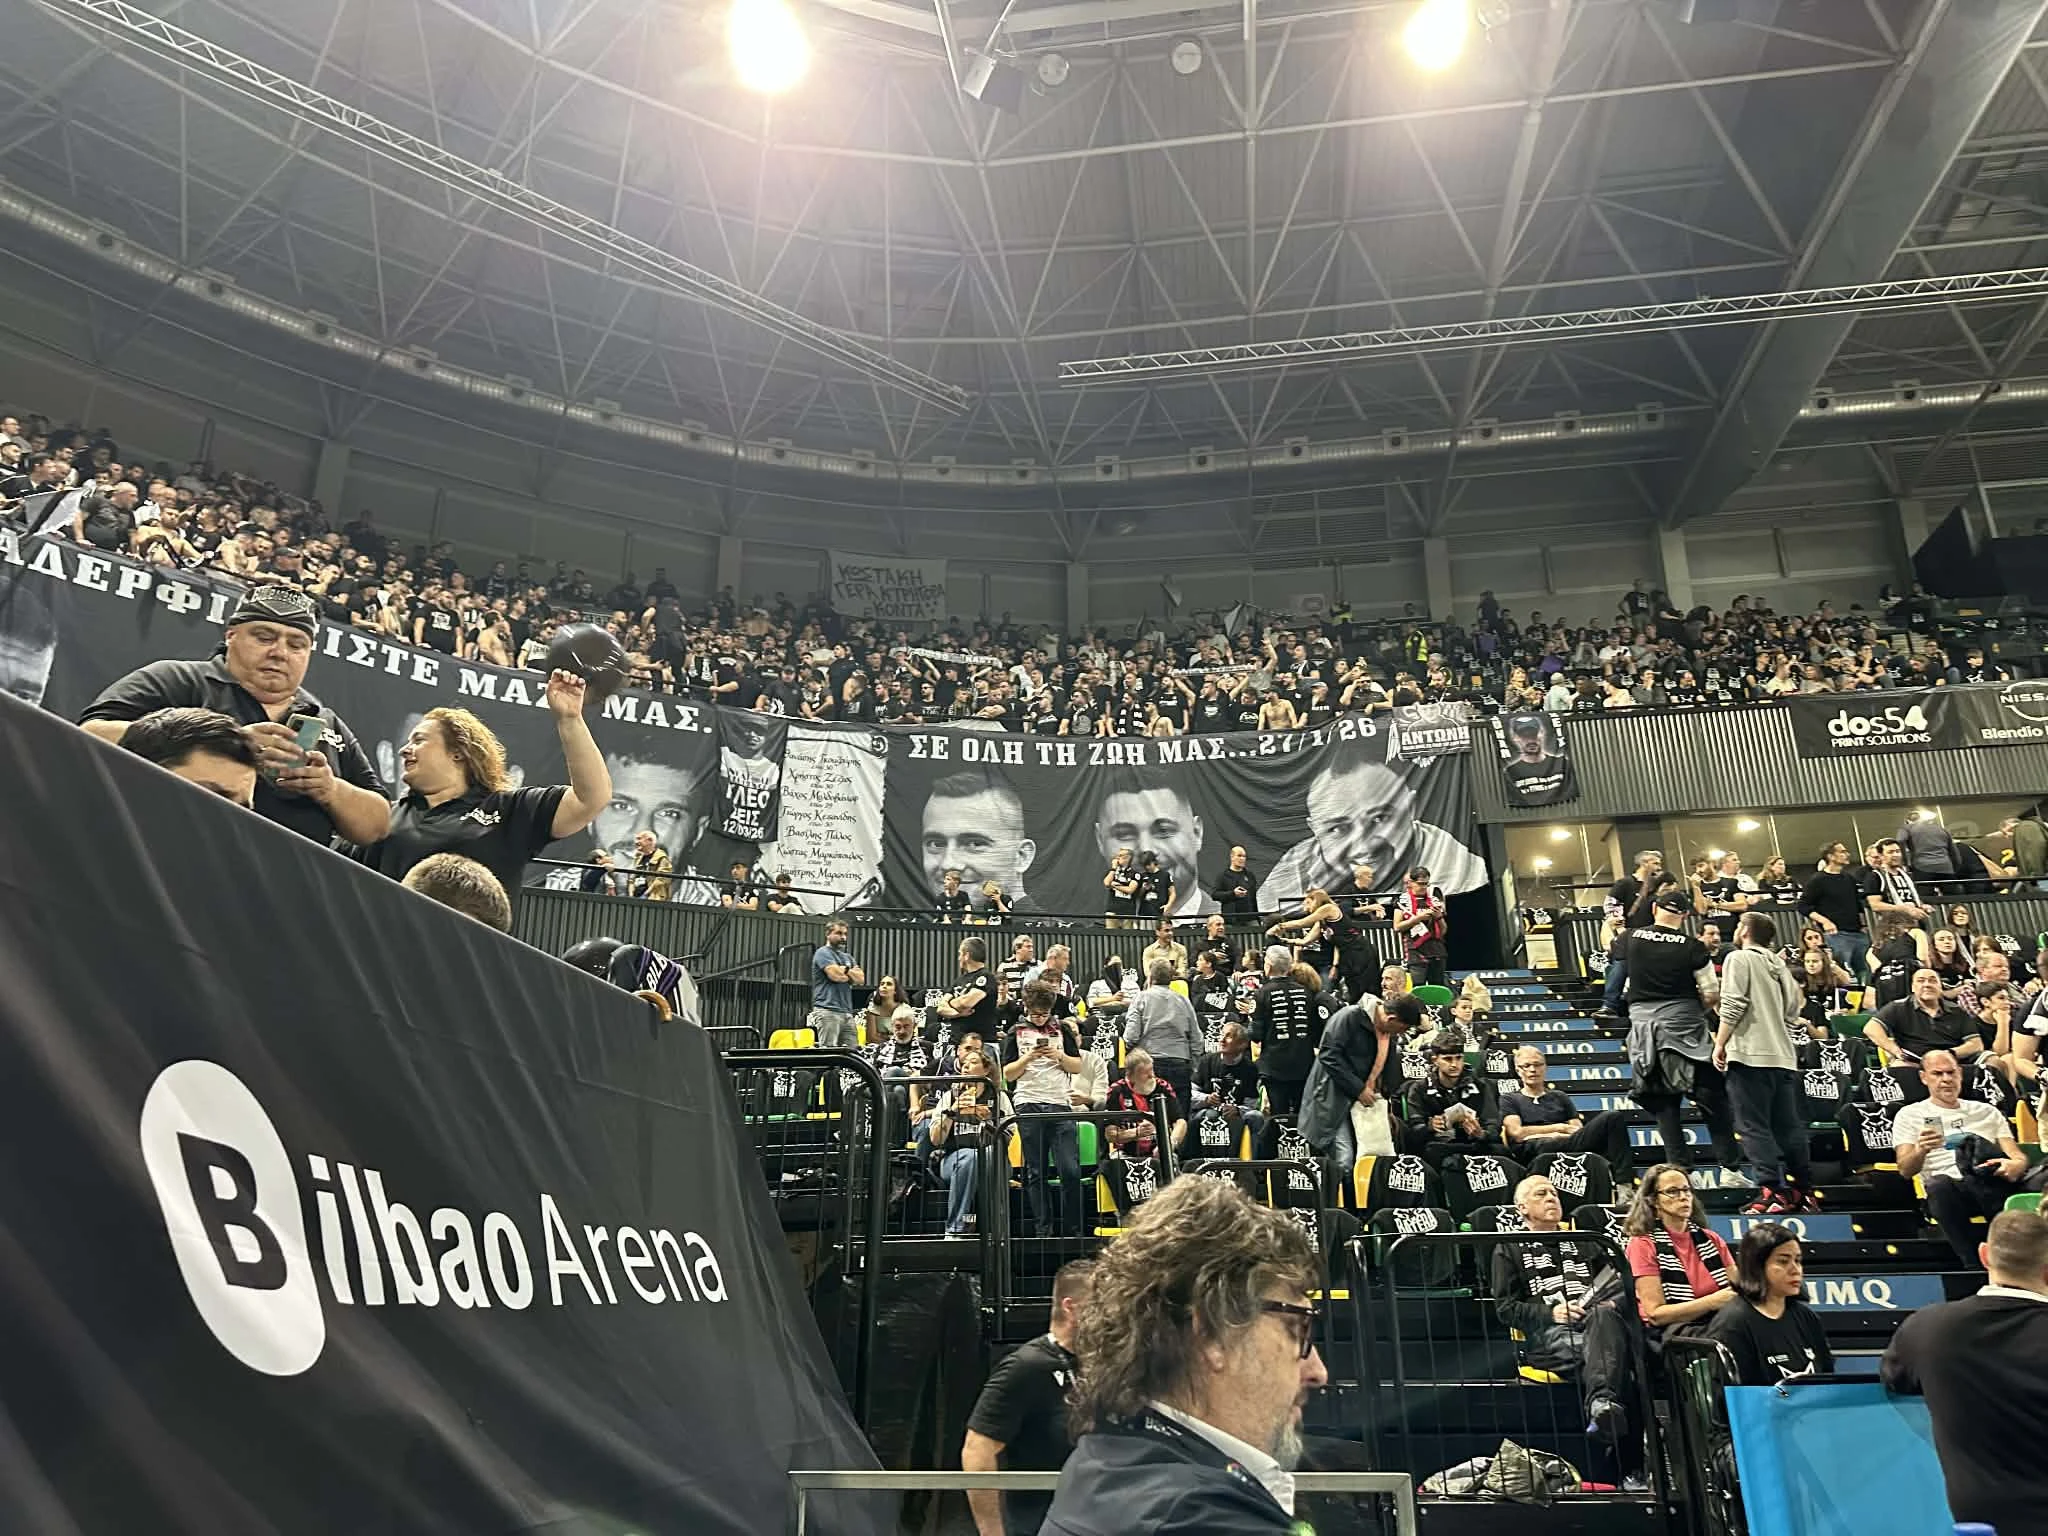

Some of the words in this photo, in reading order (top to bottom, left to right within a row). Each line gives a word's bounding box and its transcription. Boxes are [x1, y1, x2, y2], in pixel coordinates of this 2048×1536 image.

[0, 528, 229, 624] ΑΔΕΡΦΙ
[2001, 692, 2048, 703] NISS
[1827, 705, 1929, 737] dos54
[1401, 726, 1470, 746] ΑΝΤΩΝΗ
[1831, 737, 1866, 748] PRINT
[1866, 732, 1932, 746] SOLUTIONS
[1981, 726, 2044, 739] Blendio
[908, 734, 949, 760] ΣΕ
[962, 738, 1024, 765] ΟΛΗ
[1036, 743, 1076, 766] ΤΗ
[1088, 742, 1146, 766] ΖΩΗ
[722, 819, 764, 839] 12/03/26
[1632, 930, 1686, 944] macron
[1804, 1078, 1840, 1100] BATERA
[1869, 1081, 1905, 1103] BATERA
[1861, 1128, 1894, 1149] BATER
[1388, 1169, 1425, 1193] BATERA
[1466, 1165, 1509, 1193] BATERA
[1549, 1168, 1588, 1197] BATERA
[177, 1130, 533, 1311] Bilbao
[540, 1193, 729, 1305] Arena
[1806, 1279, 1899, 1309] IMQ
